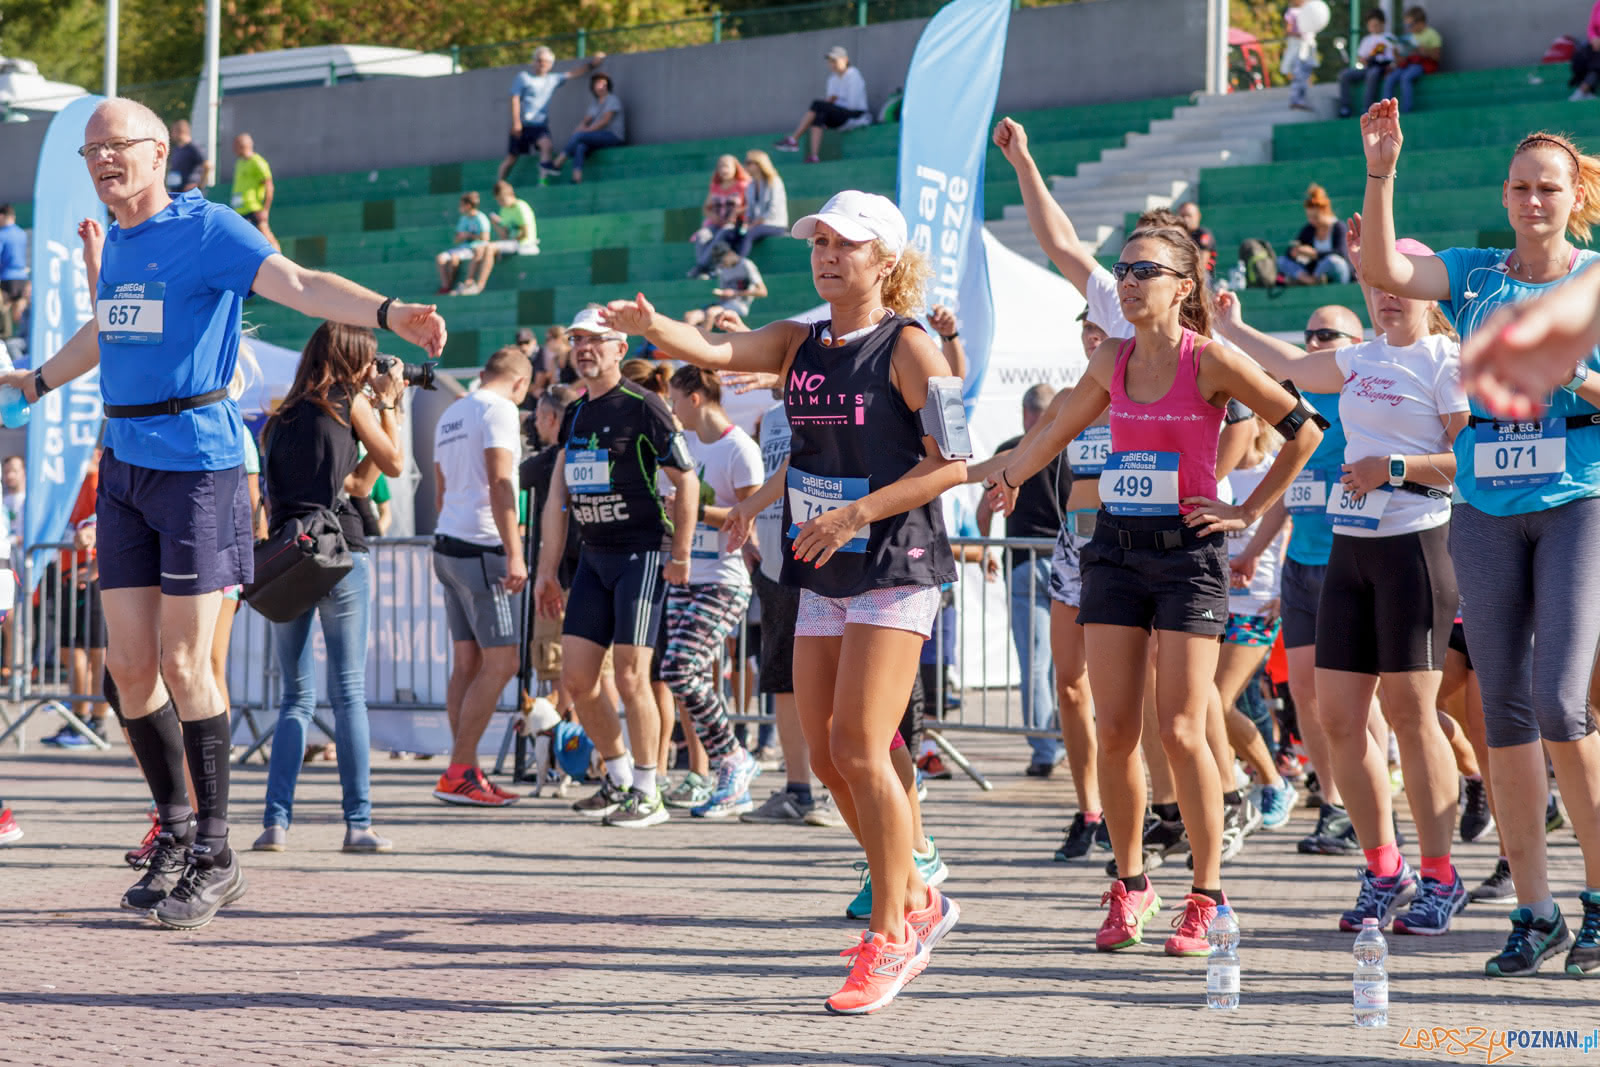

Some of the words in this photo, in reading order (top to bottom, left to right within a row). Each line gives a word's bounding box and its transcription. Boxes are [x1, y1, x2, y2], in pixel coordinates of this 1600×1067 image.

[109, 305, 141, 325] 657
[789, 369, 826, 392] NO
[789, 393, 864, 406] LIMITS
[1505, 432, 1543, 441] FUNdusze
[1080, 444, 1109, 460] 215
[1121, 452, 1157, 464] zaBIEGaj
[1496, 445, 1537, 470] 071
[573, 466, 594, 481] 001
[802, 475, 843, 493] zaBIEGaj
[1113, 475, 1153, 497] 499
[807, 486, 843, 499] FUNdusze
